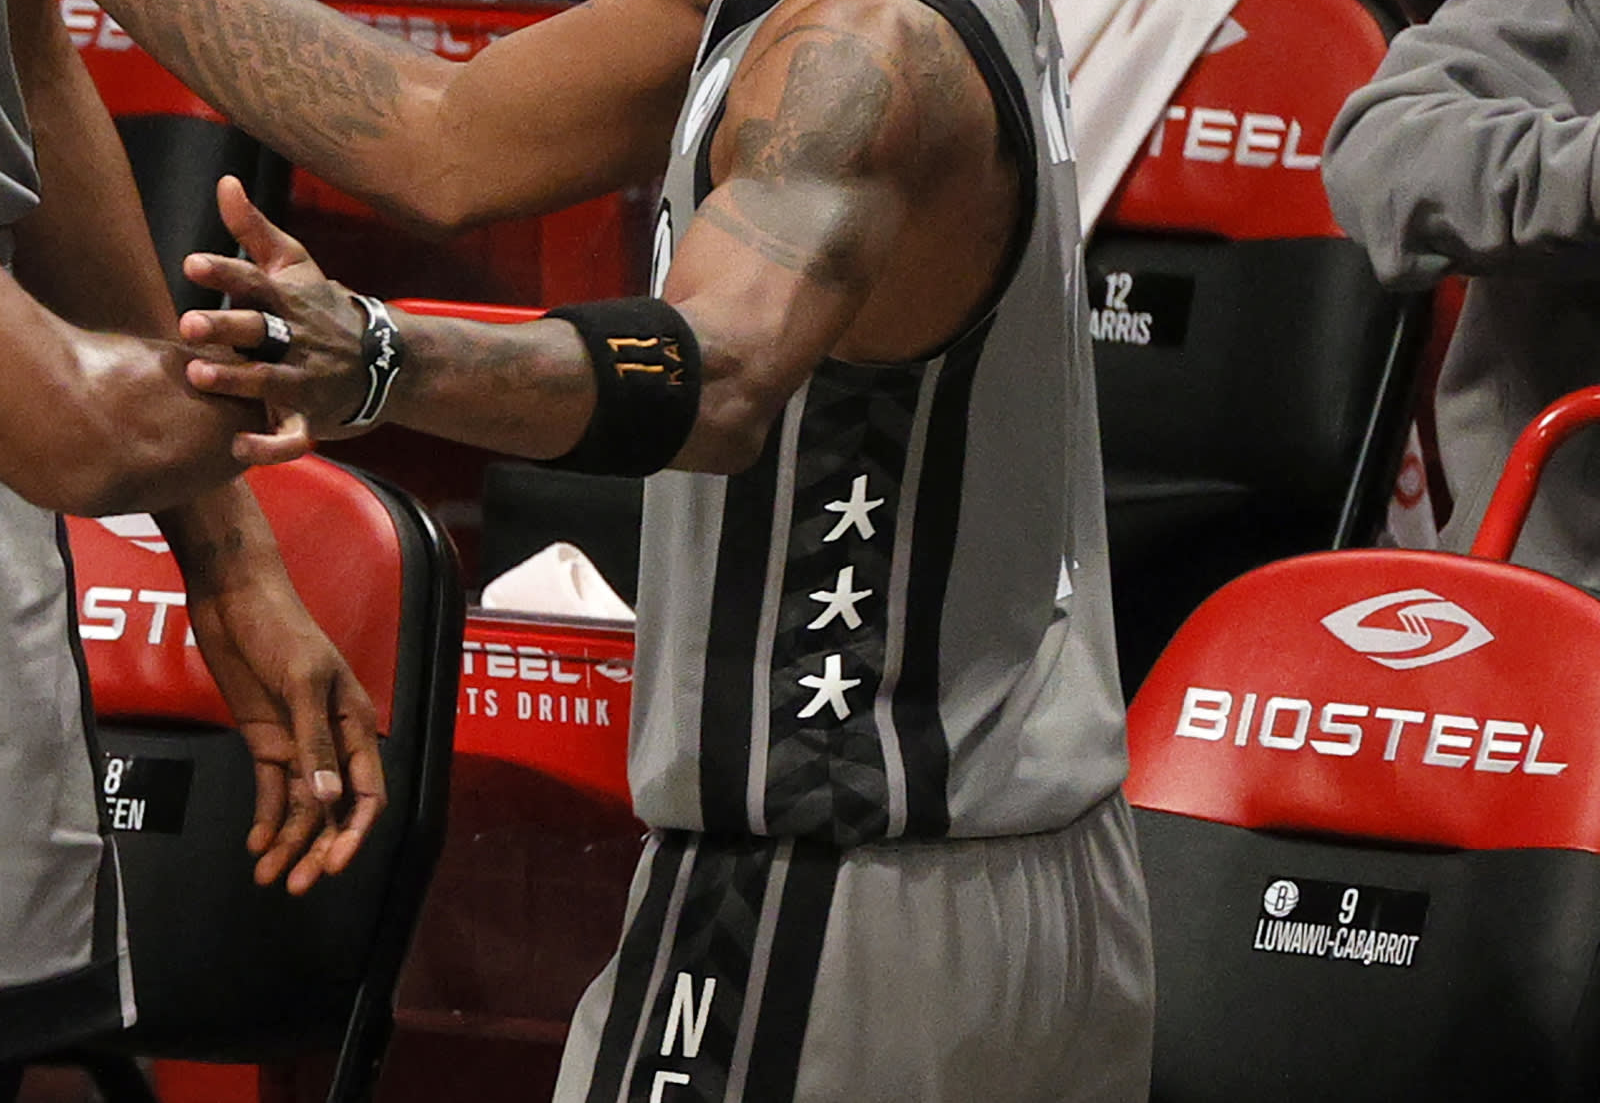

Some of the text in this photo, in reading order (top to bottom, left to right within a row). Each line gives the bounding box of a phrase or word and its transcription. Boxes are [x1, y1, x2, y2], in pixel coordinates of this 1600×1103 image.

[1105, 271, 1133, 310] 12
[1090, 307, 1153, 346] ARRIS
[79, 586, 197, 647] ST
[456, 687, 611, 727] TS DRINK
[1174, 686, 1568, 776] BIOSTEEL
[103, 758, 125, 795] 8
[1337, 887, 1360, 925] 9
[1253, 917, 1420, 967] LUWAWU-CABARROT
